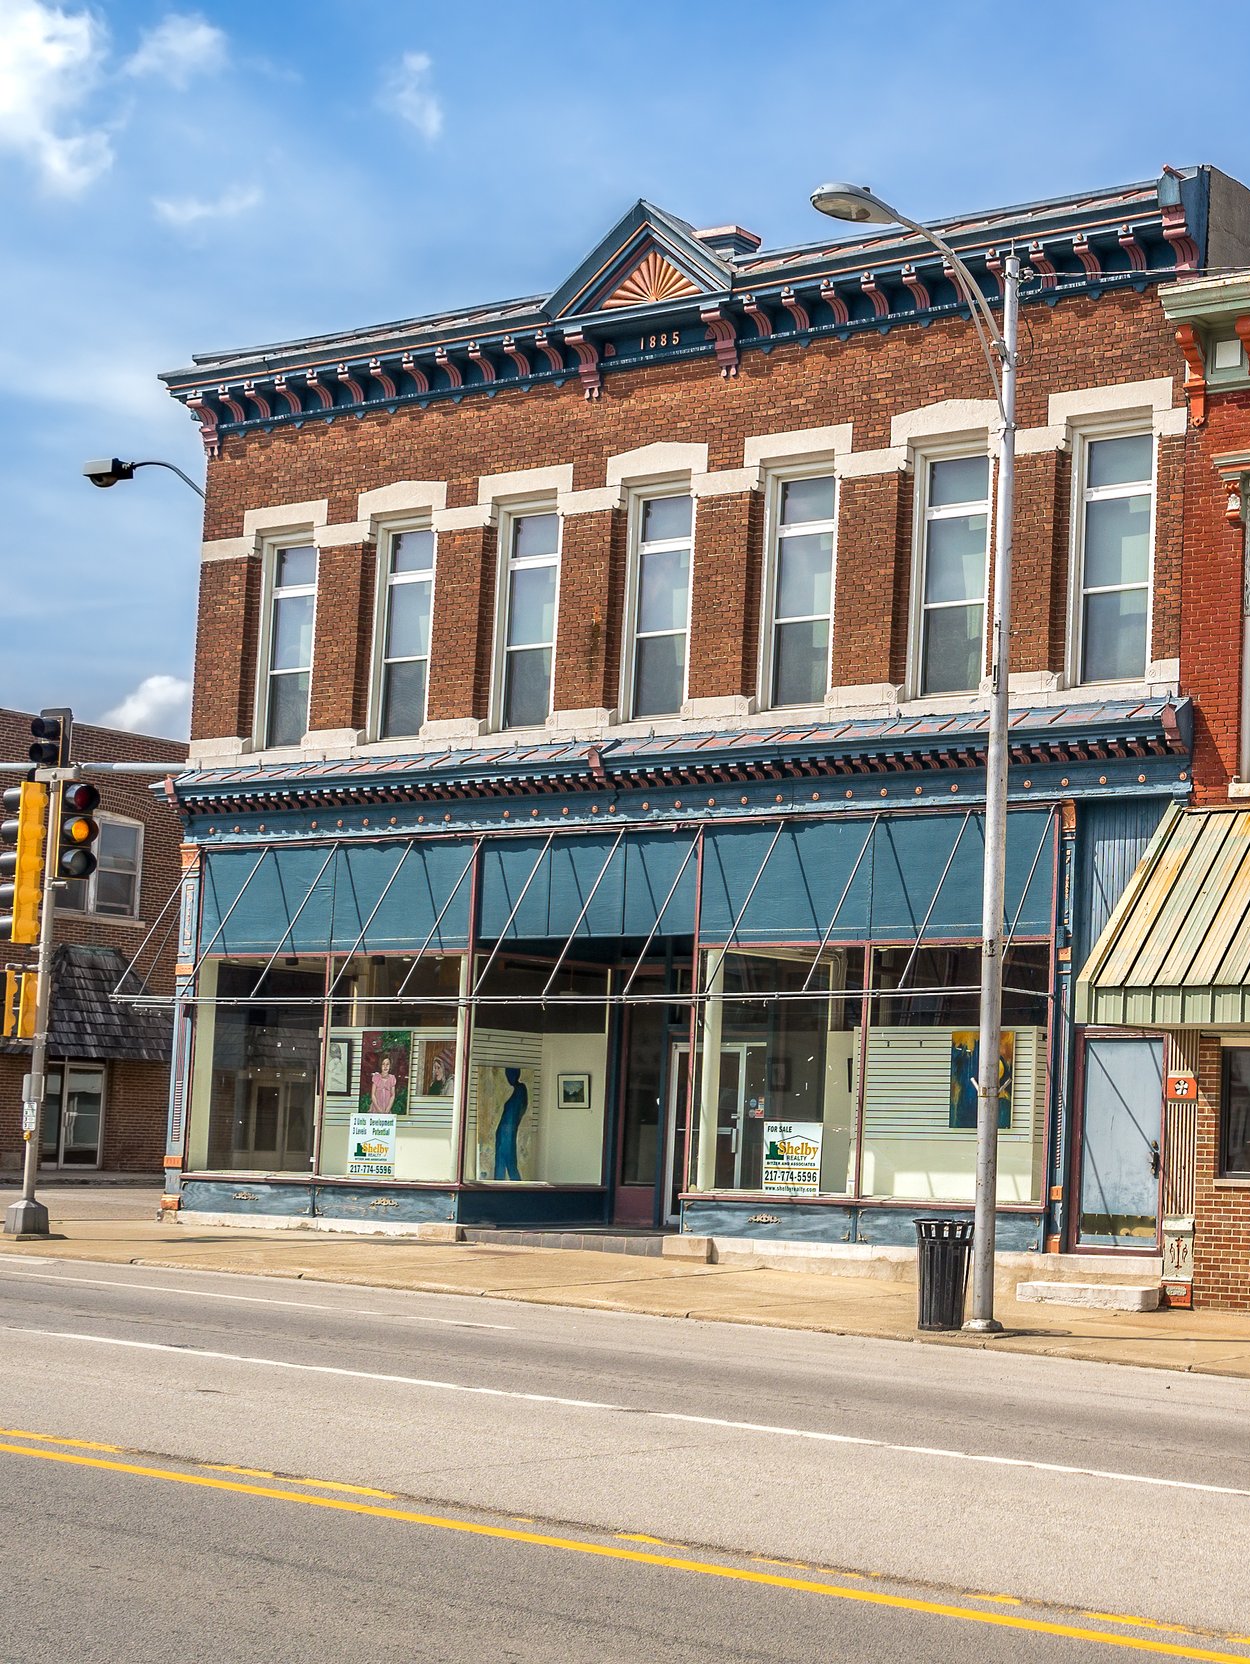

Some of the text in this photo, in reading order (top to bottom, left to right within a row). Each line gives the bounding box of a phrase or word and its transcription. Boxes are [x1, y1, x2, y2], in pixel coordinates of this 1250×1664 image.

[640, 331, 680, 350] 1885
[370, 1118, 394, 1128] Development
[767, 1125, 793, 1133] FOR SALE
[363, 1142, 389, 1157] Shelby
[777, 1141, 819, 1160] Shelby
[350, 1164, 392, 1174] 217-774-5596
[764, 1170, 817, 1183] 217-774-5596
